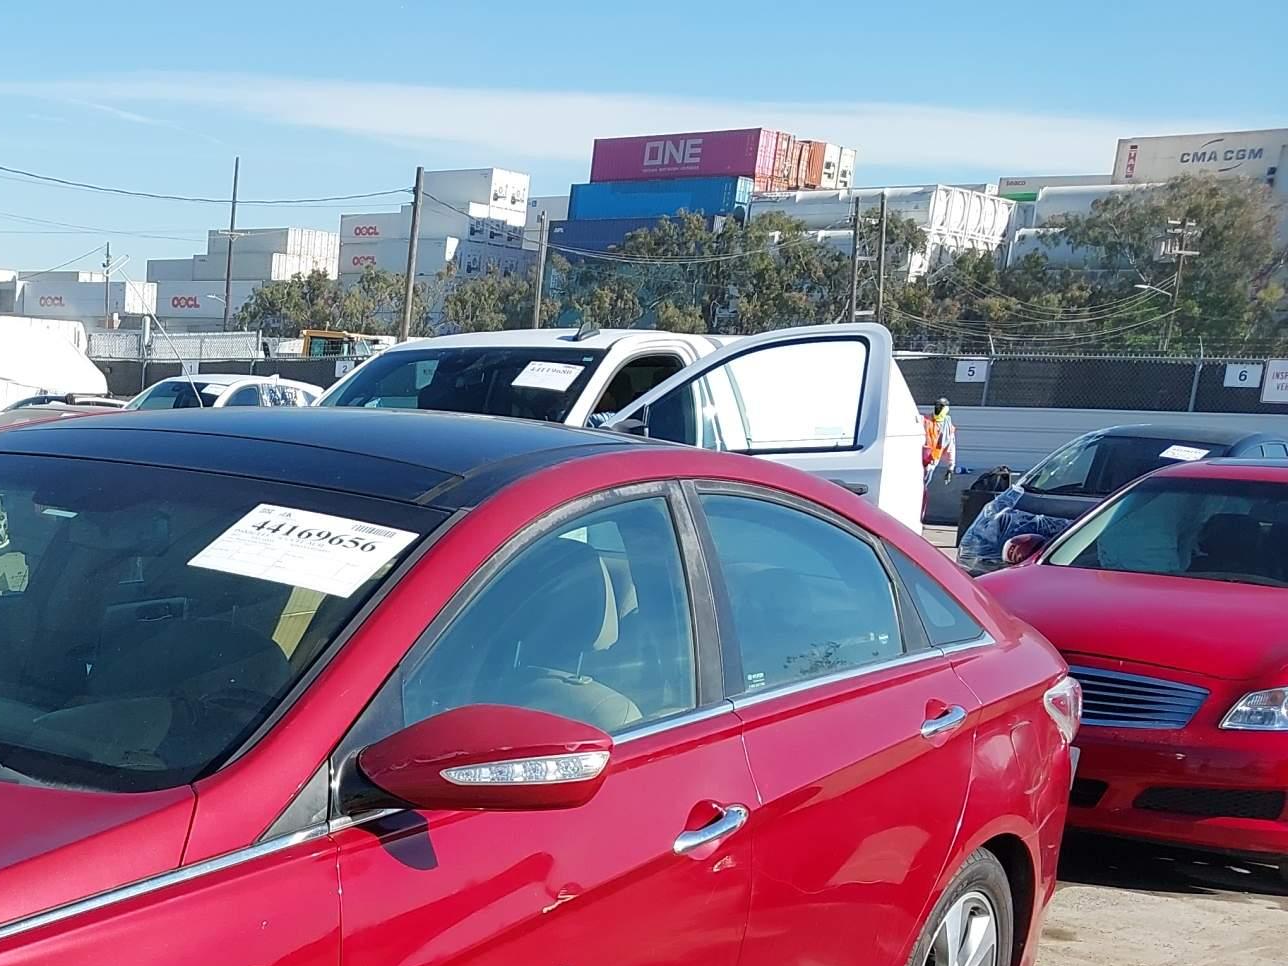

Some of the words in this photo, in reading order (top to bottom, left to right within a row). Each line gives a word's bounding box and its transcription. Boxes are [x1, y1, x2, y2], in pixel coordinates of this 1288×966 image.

[643, 139, 703, 166] ONE
[1180, 151, 1218, 163] CMA
[1223, 148, 1264, 161] CGM
[354, 226, 380, 236] OOCL
[39, 296, 65, 307] OOCL
[171, 296, 200, 308] OOCL
[967, 366, 977, 377] 5
[1238, 370, 1248, 382] 6
[251, 519, 382, 554] 44169656
